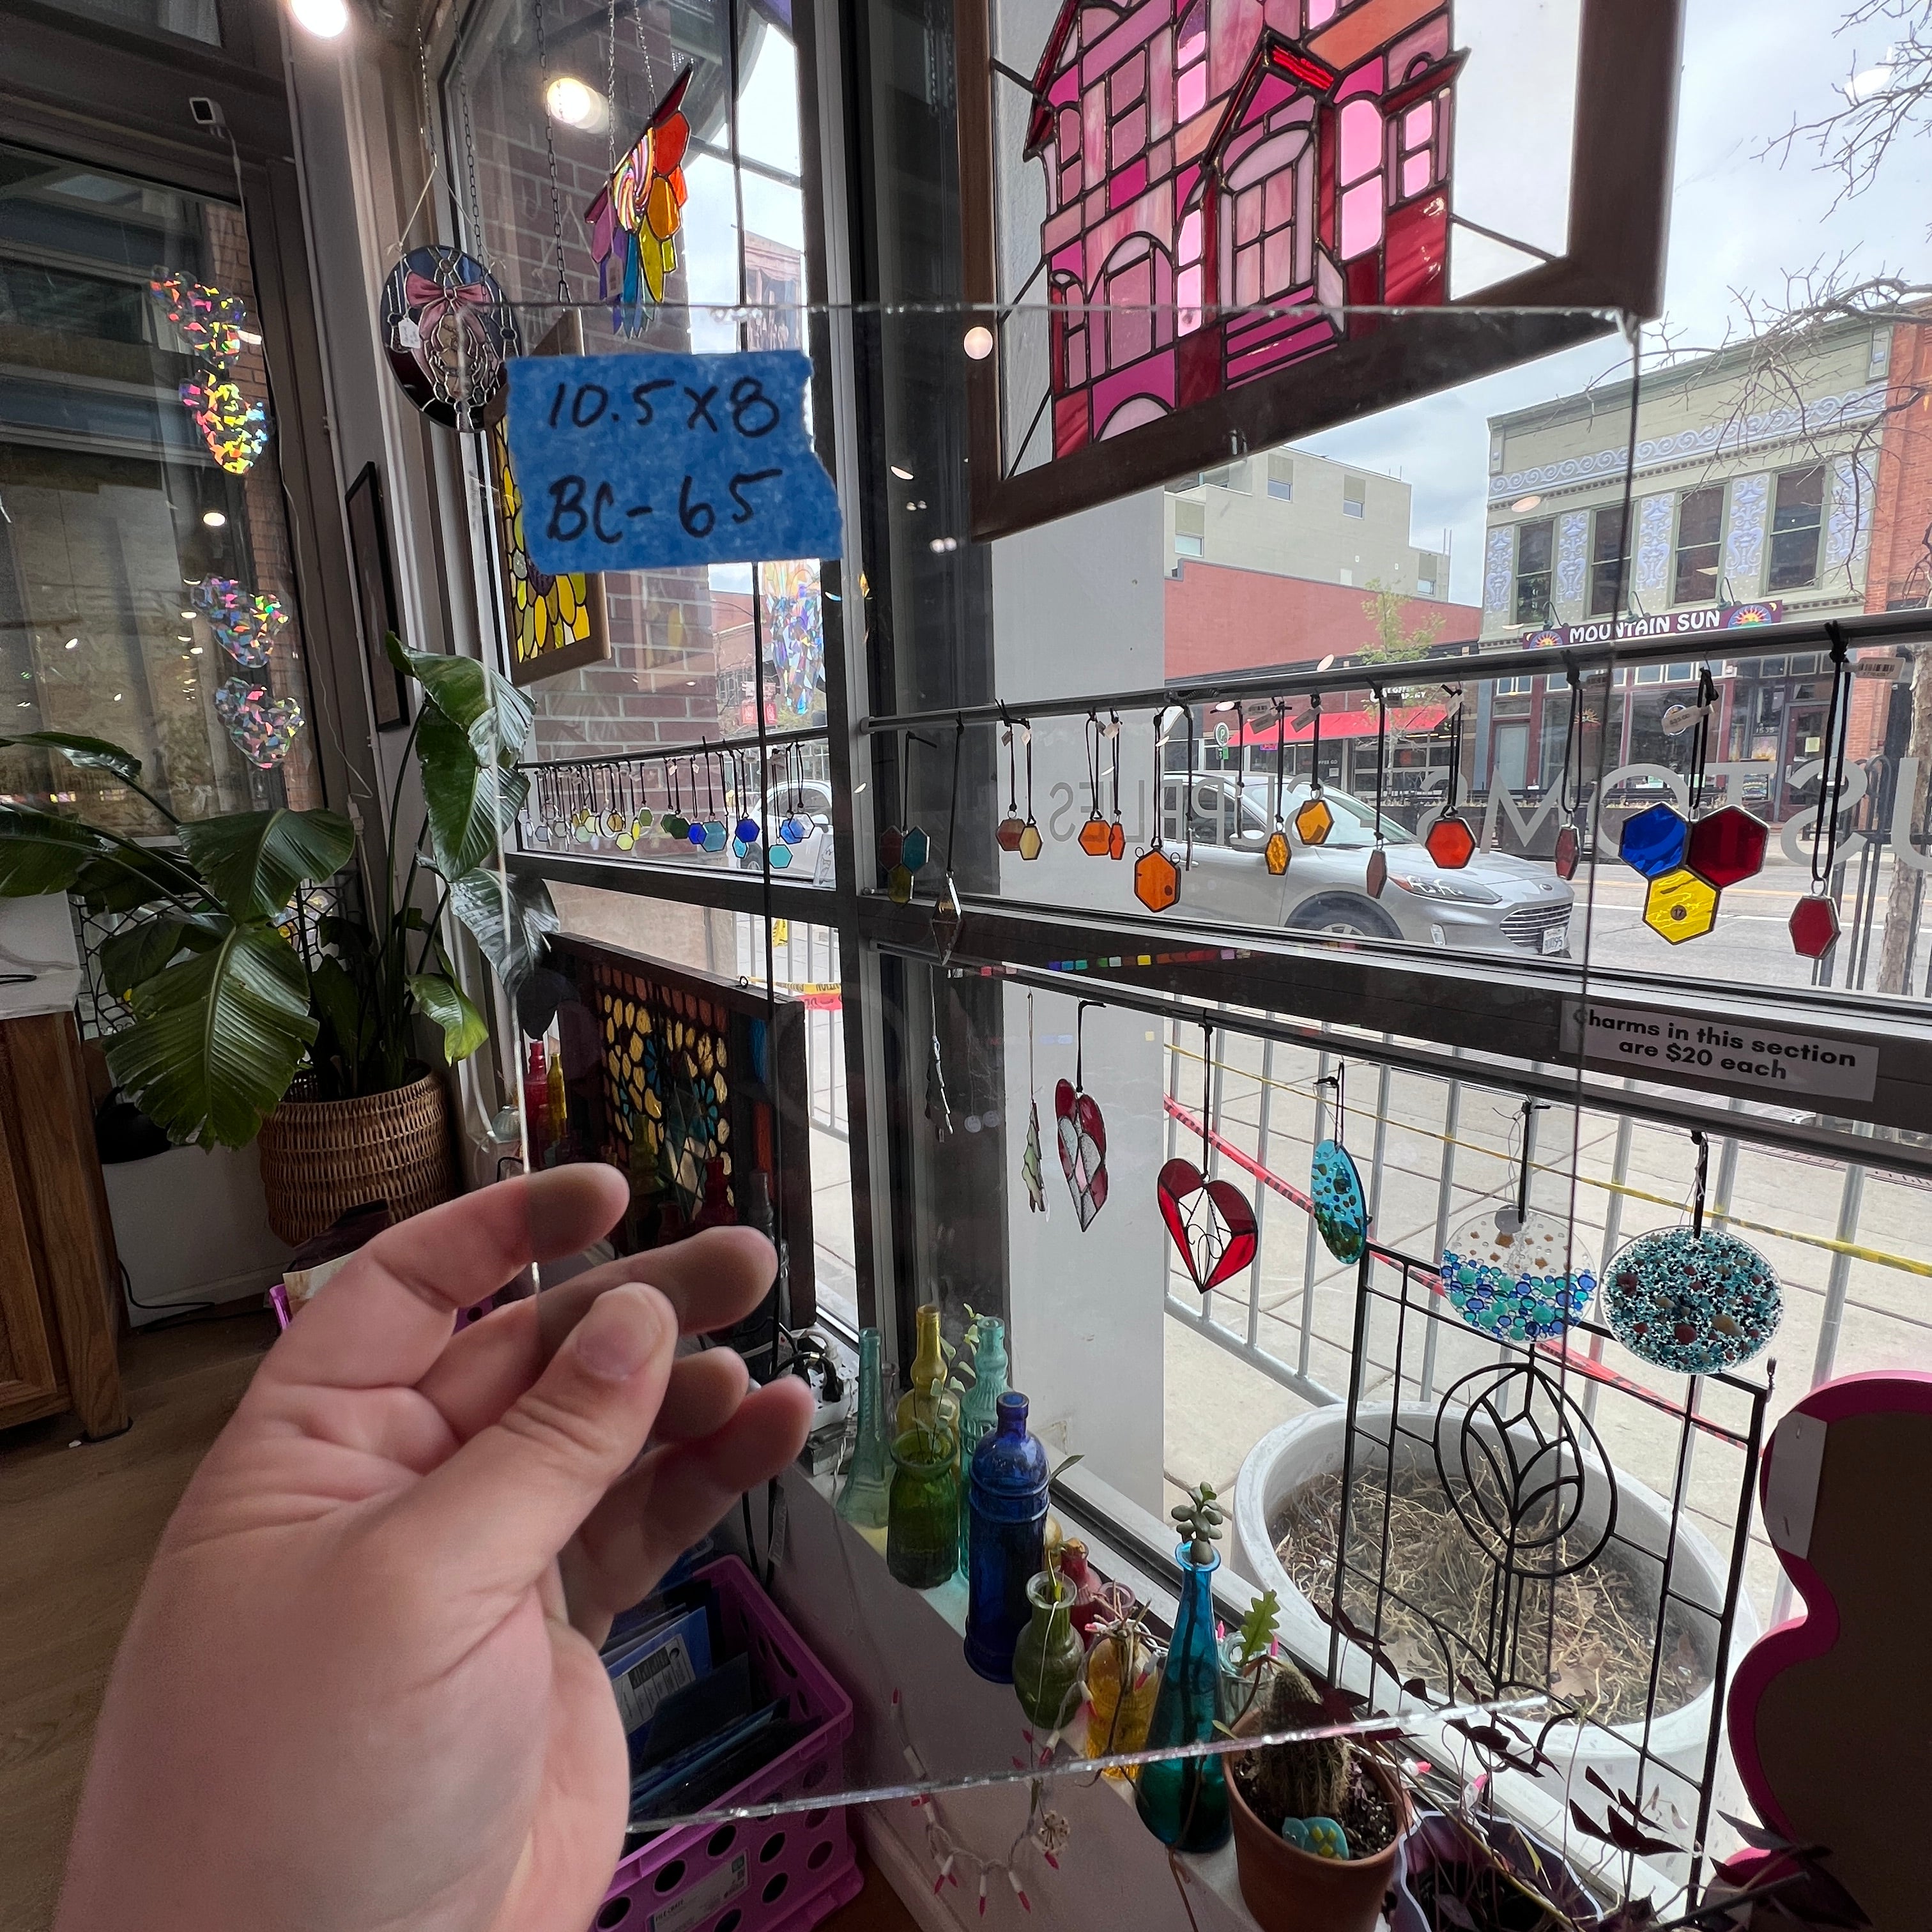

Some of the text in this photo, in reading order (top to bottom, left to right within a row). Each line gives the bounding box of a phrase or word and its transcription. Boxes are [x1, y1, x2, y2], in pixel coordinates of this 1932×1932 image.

[546, 468, 783, 544] BC-65
[1569, 610, 1721, 644] MOUNTAIN SUN
[1619, 1040, 1787, 1080] are $20 each
[1667, 1022, 1689, 1041] in
[1696, 1026, 1744, 1050] this
[1751, 1038, 1856, 1067] section
